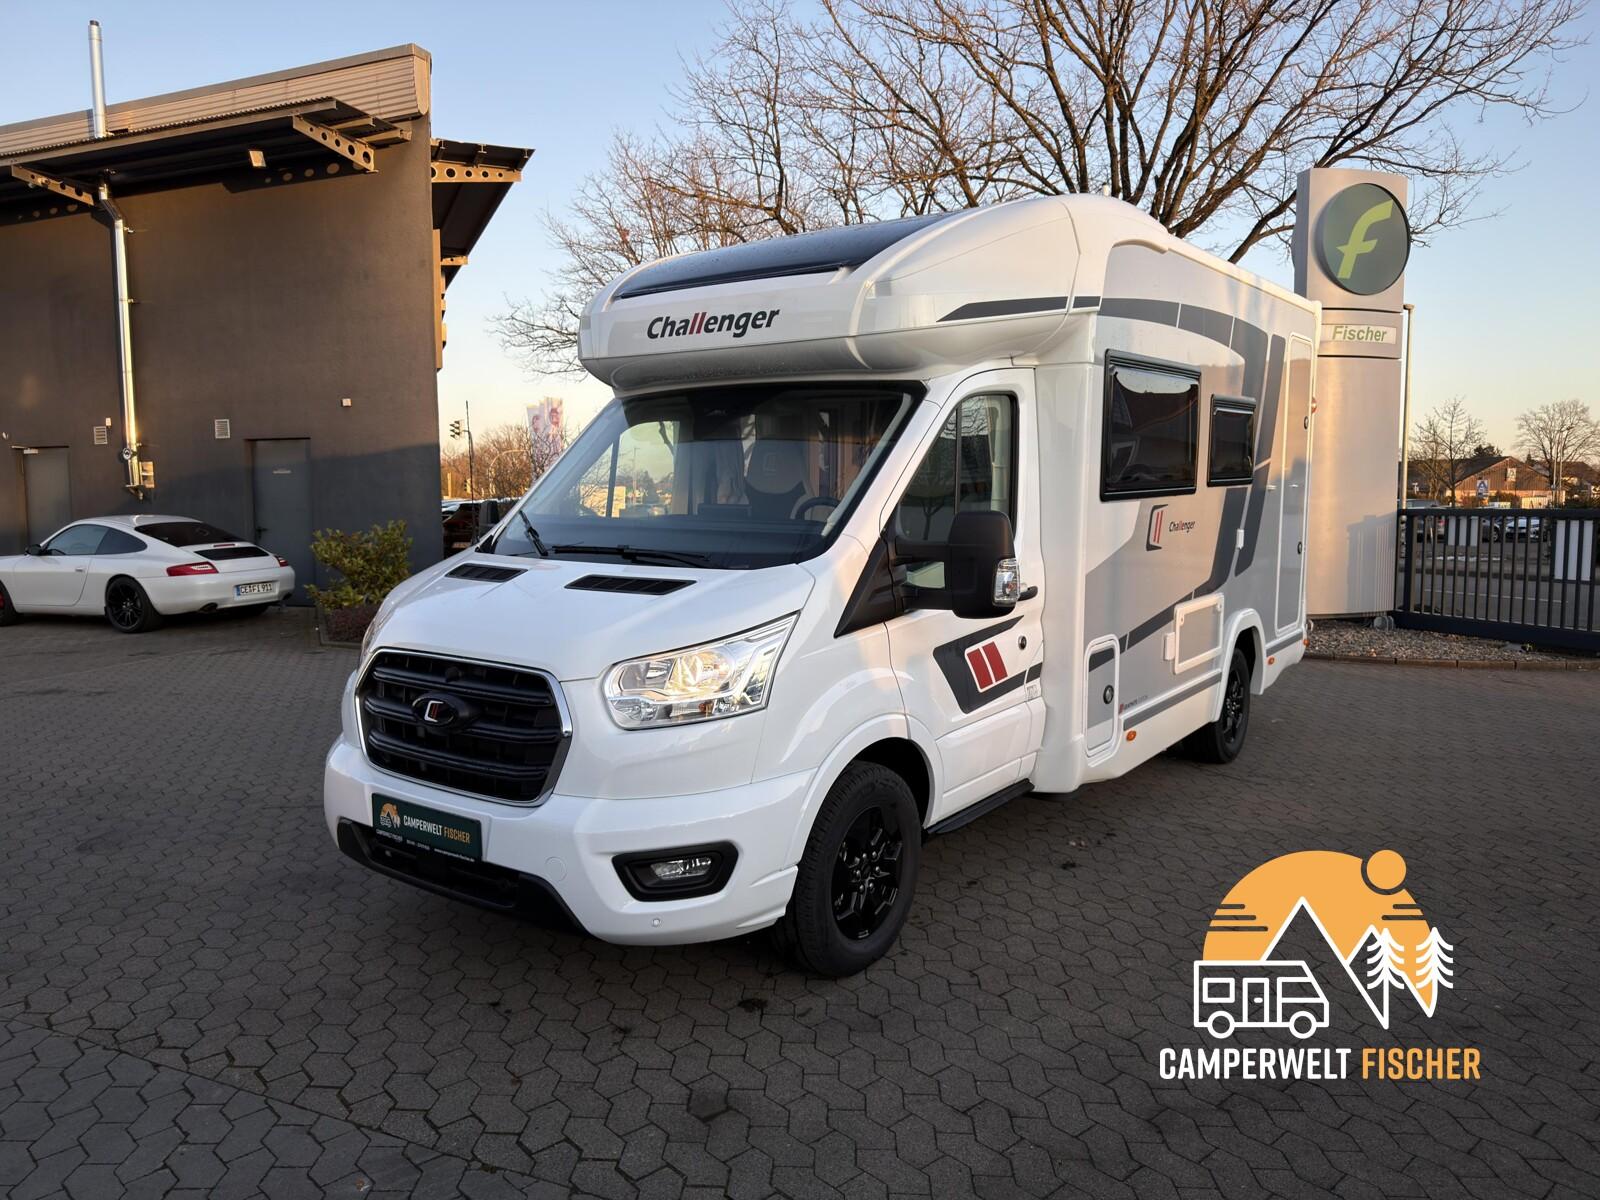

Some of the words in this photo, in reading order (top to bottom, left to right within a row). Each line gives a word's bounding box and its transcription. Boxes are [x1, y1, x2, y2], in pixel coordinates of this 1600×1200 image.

[647, 309, 780, 340] Challenger
[1332, 325, 1387, 342] Fischer
[1168, 520, 1196, 533] Challenger
[403, 815, 443, 836] CAMPERWELT
[443, 826, 471, 844] FISCHER
